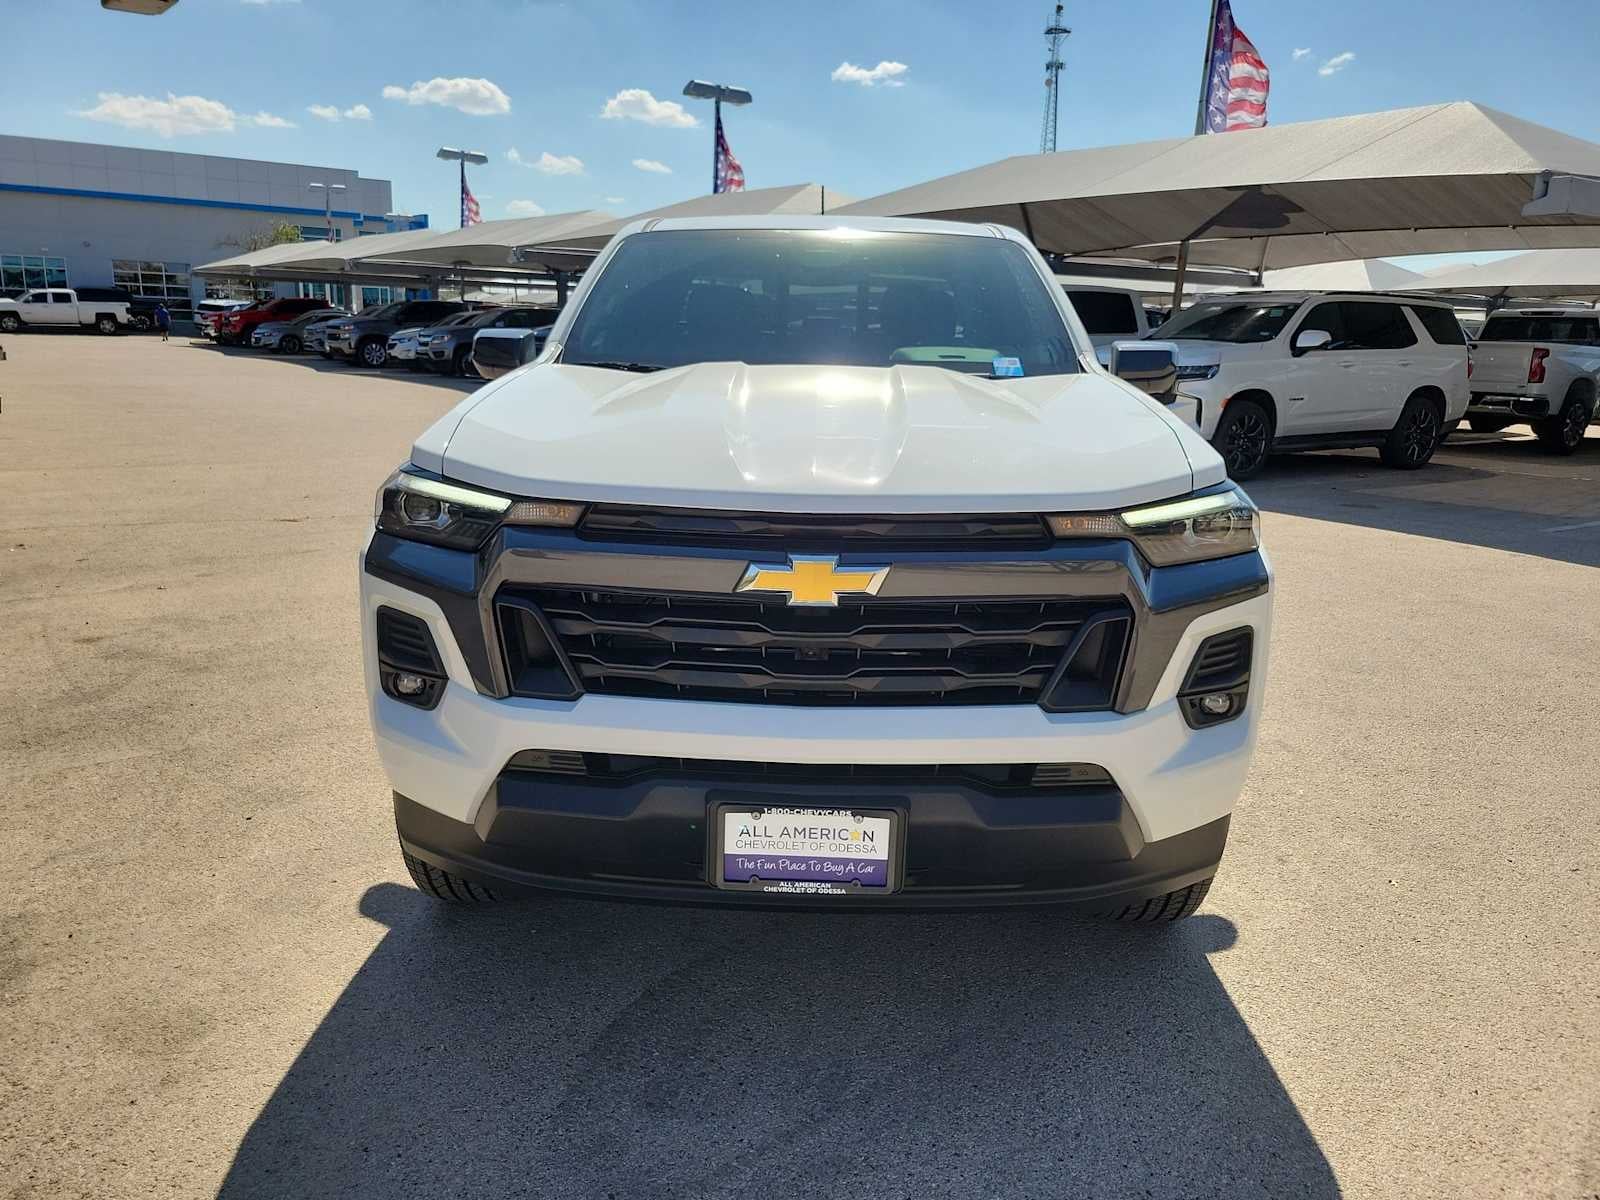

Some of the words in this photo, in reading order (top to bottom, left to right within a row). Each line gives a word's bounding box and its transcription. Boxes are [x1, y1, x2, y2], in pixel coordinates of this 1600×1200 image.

[738, 825, 773, 838] ALL
[735, 839, 808, 851] CHEVROLET
[809, 842, 827, 851] OF
[828, 843, 878, 854] ODESSA
[737, 857, 755, 870] The
[757, 858, 776, 870] Fun
[778, 858, 807, 872] Place
[808, 860, 821, 871] To
[823, 861, 844, 876] Buy
[845, 862, 855, 873] A
[857, 862, 876, 874] Car
[763, 886, 806, 894] CHEVROLET
[819, 887, 847, 895] ODESSA
[793, 881, 832, 889] AMERICAN
